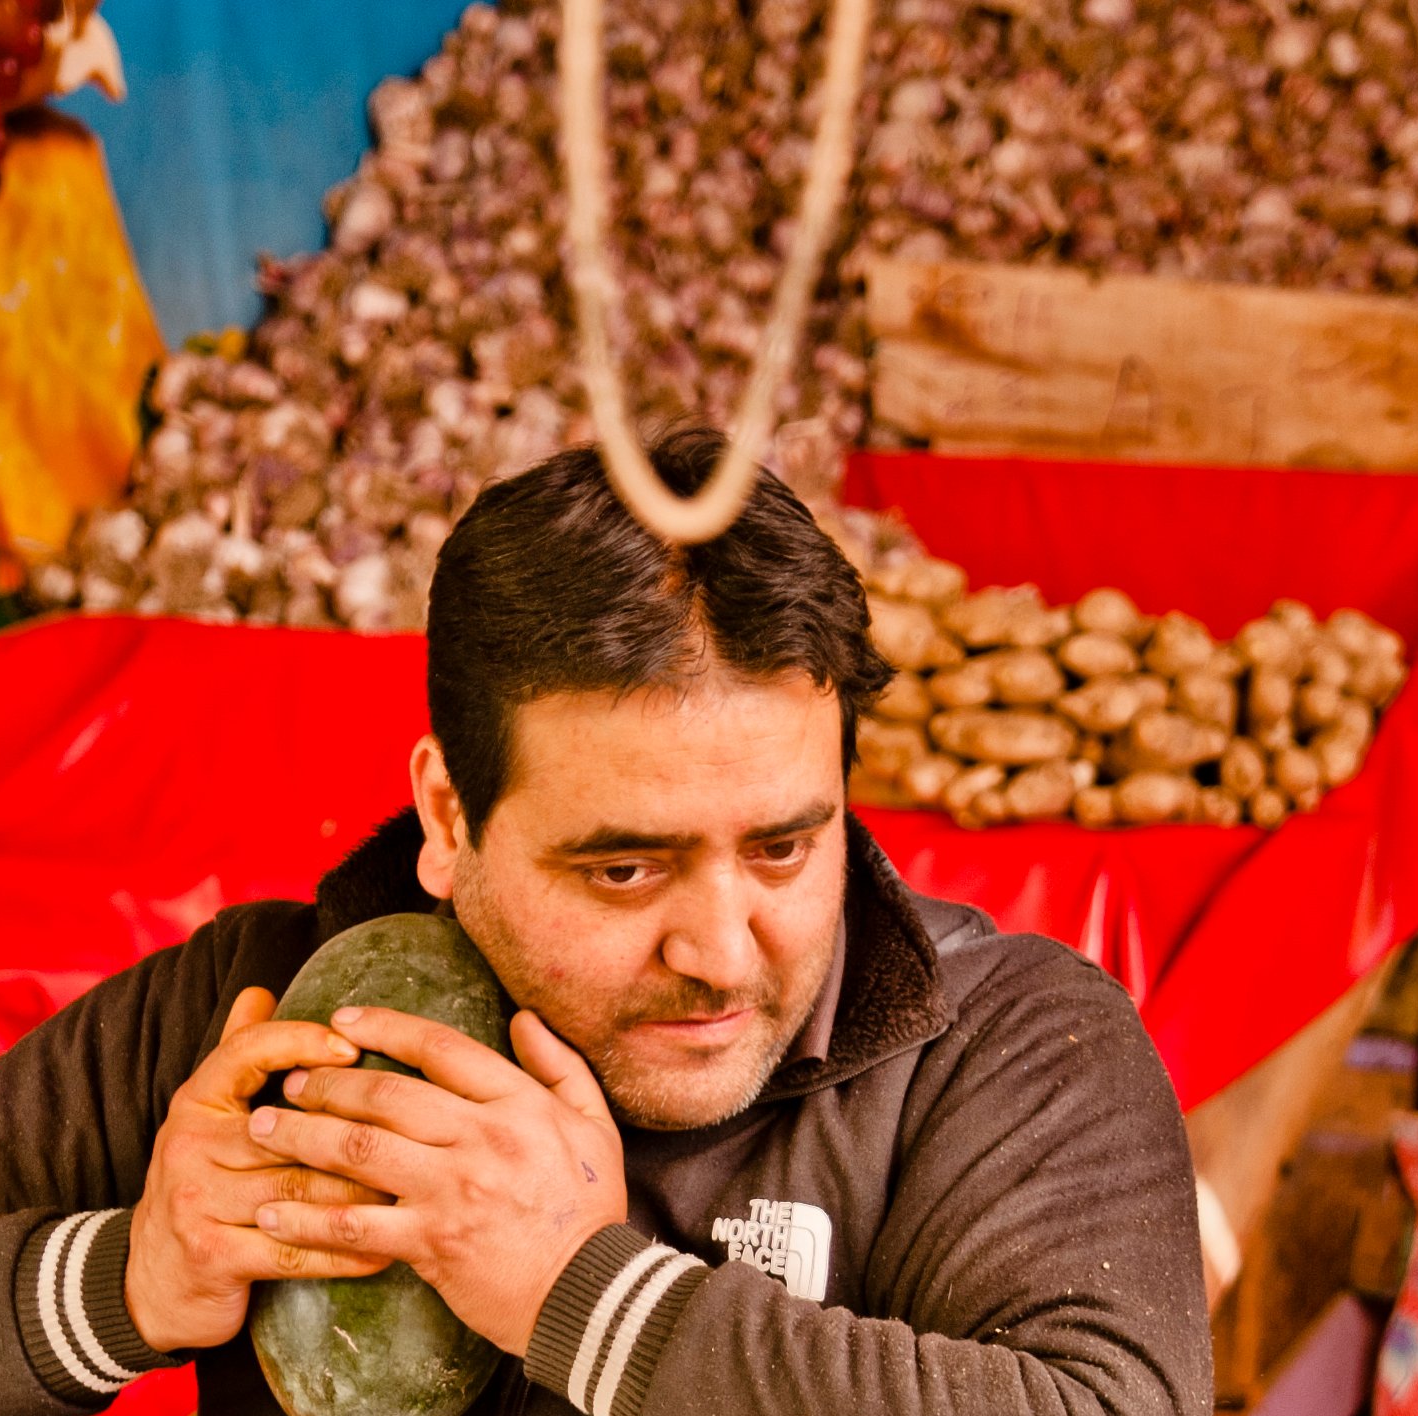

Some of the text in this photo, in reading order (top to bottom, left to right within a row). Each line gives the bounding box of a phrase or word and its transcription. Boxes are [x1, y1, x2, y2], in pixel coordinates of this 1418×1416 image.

[749, 1198, 792, 1225] THE
[711, 1217, 789, 1250] NORTH
[728, 1242, 787, 1276] FACE
